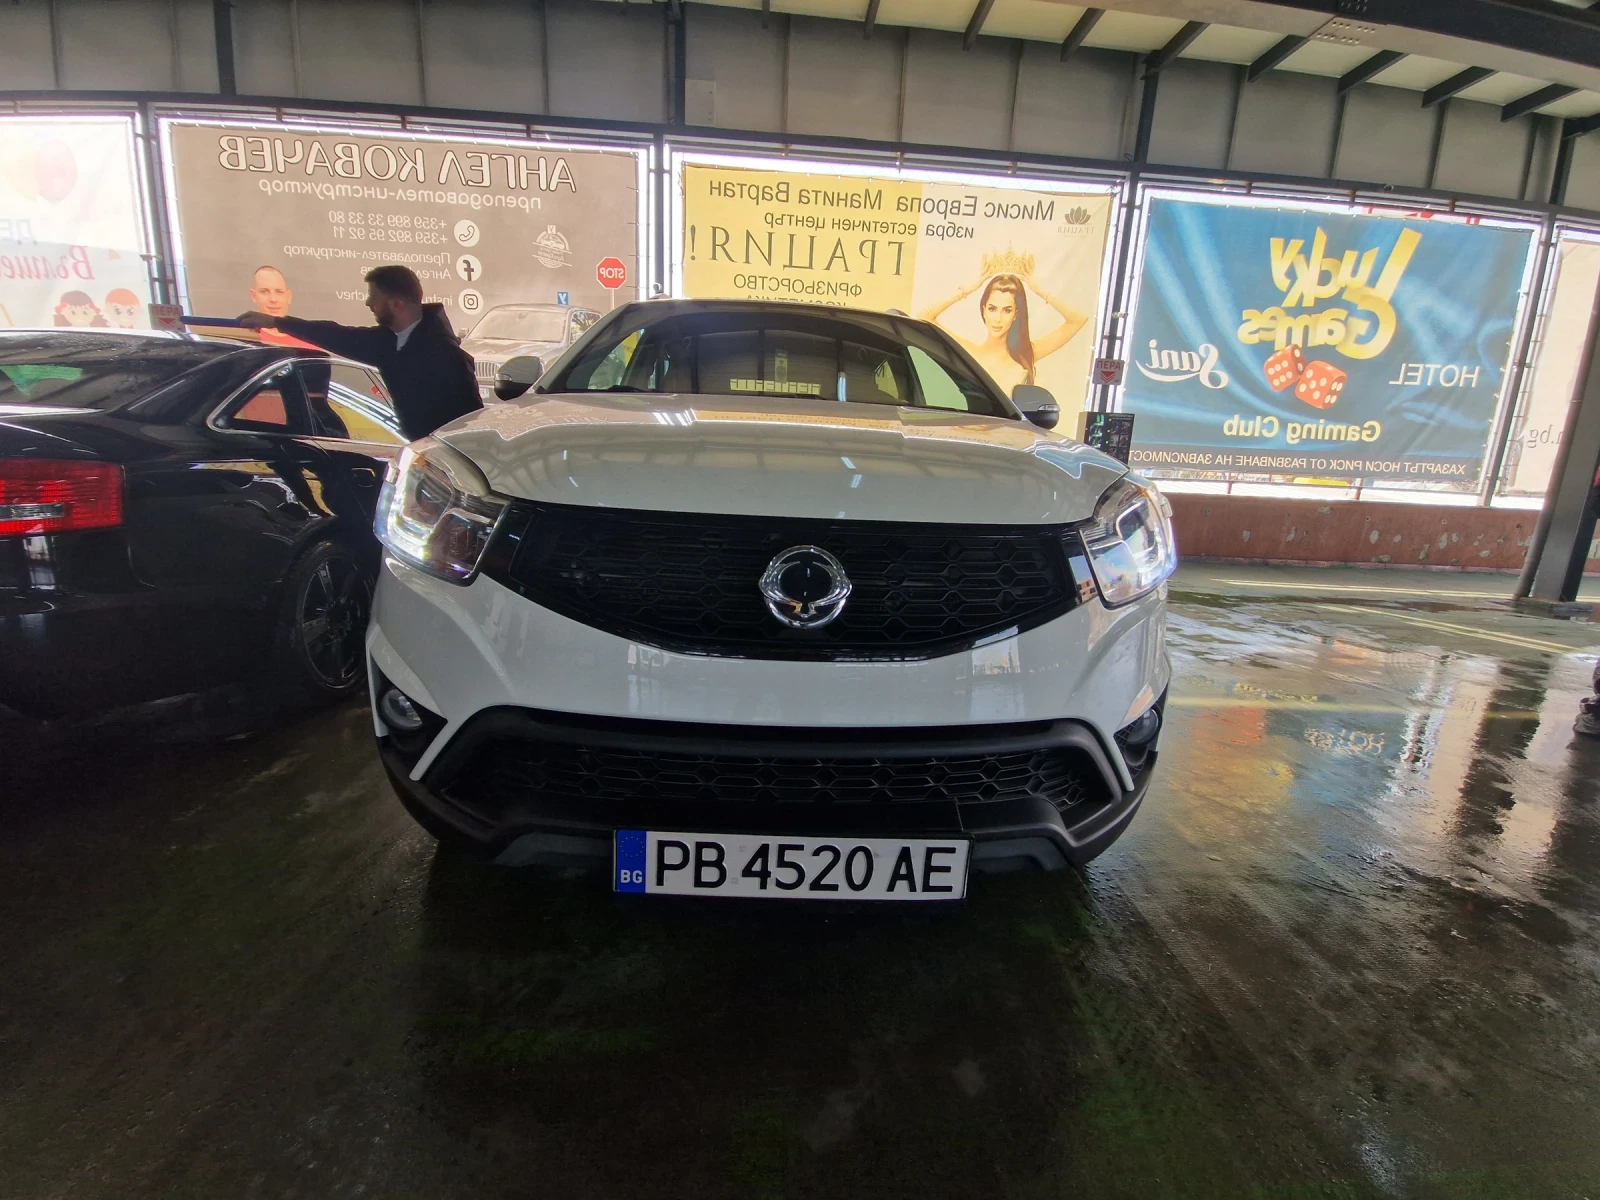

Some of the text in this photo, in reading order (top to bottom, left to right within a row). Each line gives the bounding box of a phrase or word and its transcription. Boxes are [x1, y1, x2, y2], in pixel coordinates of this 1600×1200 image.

[1096, 360, 1121, 370] ПЕРА
[656, 839, 957, 893] PB 4520 AE
[620, 870, 643, 884] BG
